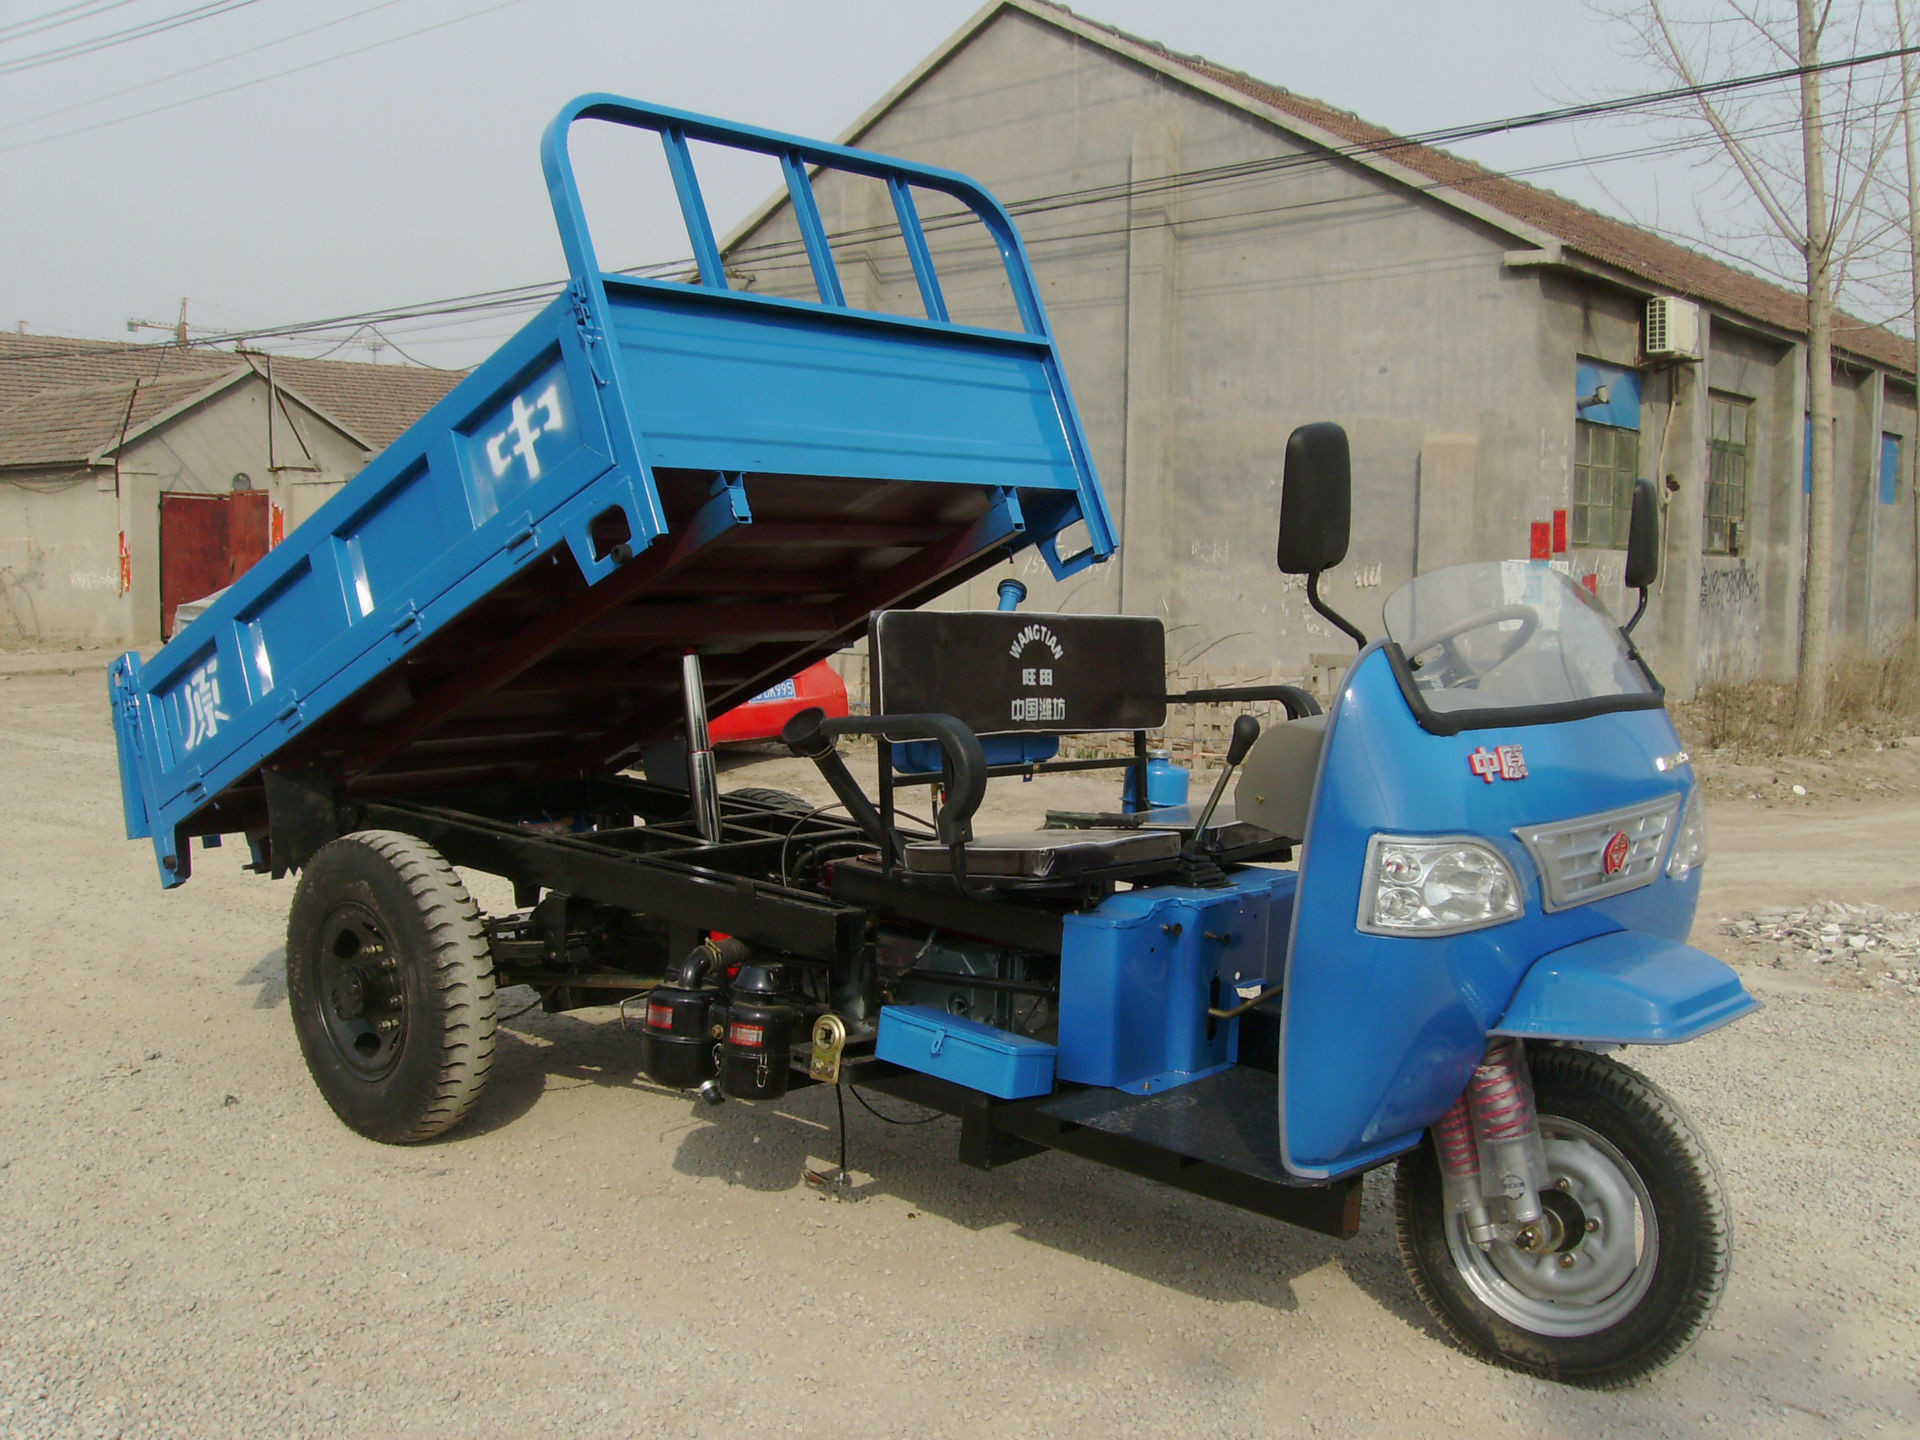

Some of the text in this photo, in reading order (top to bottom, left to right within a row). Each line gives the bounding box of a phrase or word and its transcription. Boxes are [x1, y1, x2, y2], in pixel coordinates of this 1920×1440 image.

[183, 383, 564, 750] 中 原
[1009, 624, 1064, 660] WANGTIAN
[1011, 698, 1066, 722] 中国潍坊
[1468, 744, 1529, 784] 中原
